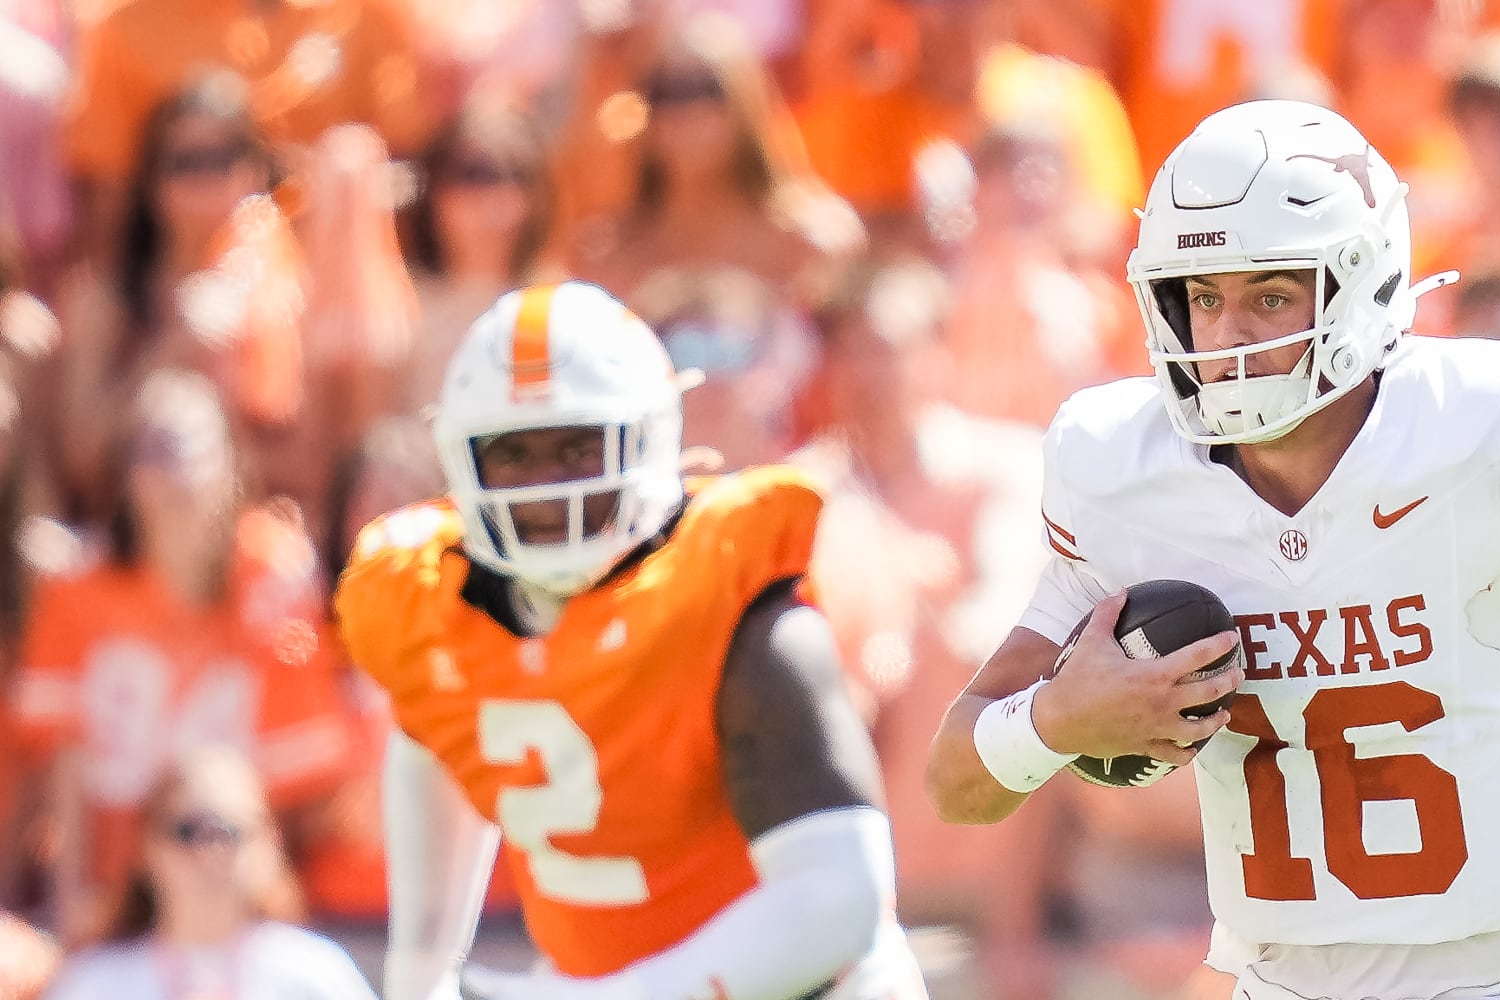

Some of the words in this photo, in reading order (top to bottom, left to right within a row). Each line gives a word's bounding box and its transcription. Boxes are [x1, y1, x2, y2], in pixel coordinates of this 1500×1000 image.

[1177, 231, 1226, 249] HORNS
[1232, 594, 1434, 681] EXAS
[478, 699, 650, 905] 2
[1226, 680, 1469, 901] 16
